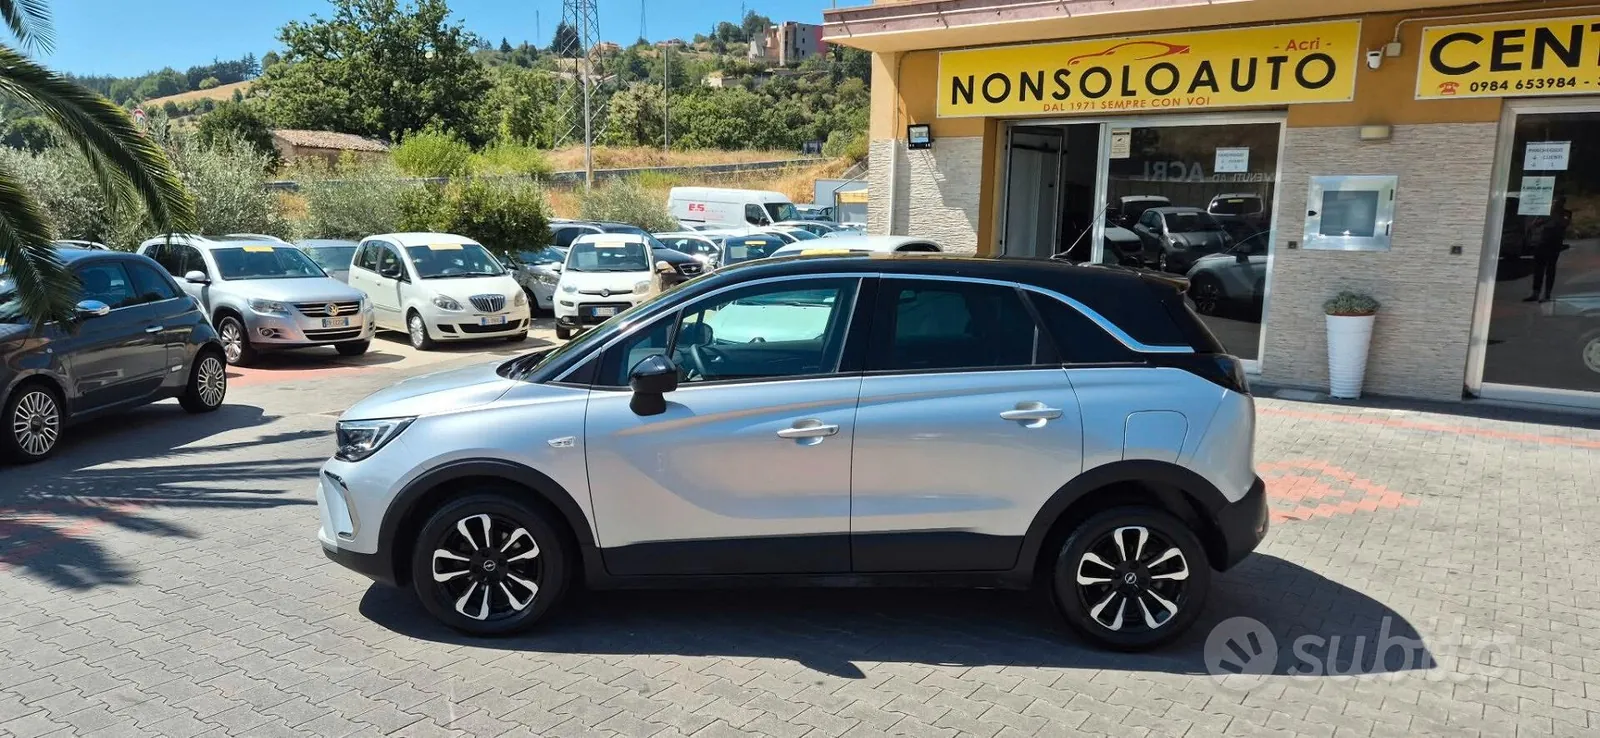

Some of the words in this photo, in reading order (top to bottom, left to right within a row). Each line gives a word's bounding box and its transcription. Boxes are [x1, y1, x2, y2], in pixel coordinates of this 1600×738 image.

[1285, 37, 1320, 51] Acri
[951, 52, 1337, 105] NONSOLOAUTO
[1469, 80, 1509, 92] 0984
[1515, 76, 1576, 90] 653984
[1043, 102, 1065, 112] DAL
[1070, 101, 1095, 110] 1971
[1100, 99, 1146, 110] SEMPRE
[1151, 97, 1181, 107] CON
[1186, 96, 1210, 106] VOI
